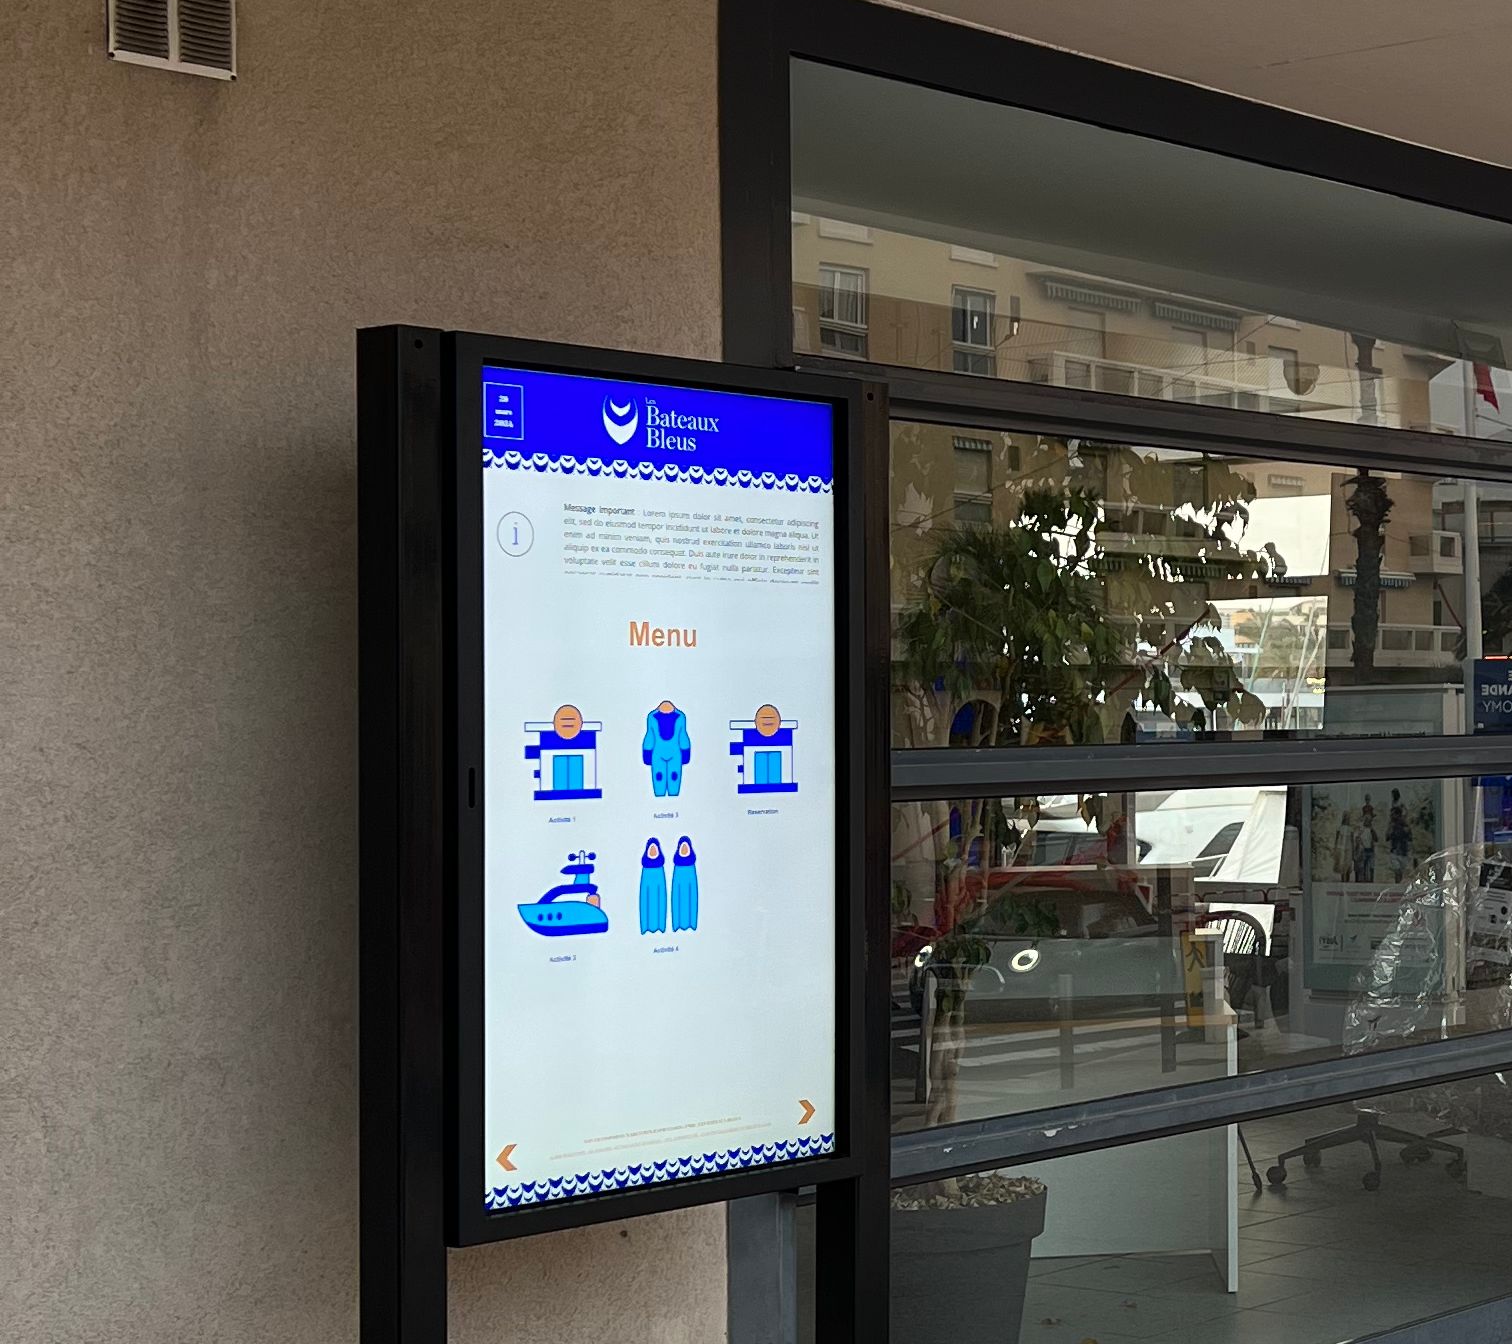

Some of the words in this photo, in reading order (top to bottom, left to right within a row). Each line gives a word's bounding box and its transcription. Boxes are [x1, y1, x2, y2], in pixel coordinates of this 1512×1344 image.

[646, 405, 720, 433] Bateaux
[646, 427, 697, 452] Bleus
[629, 620, 697, 647] Menu
